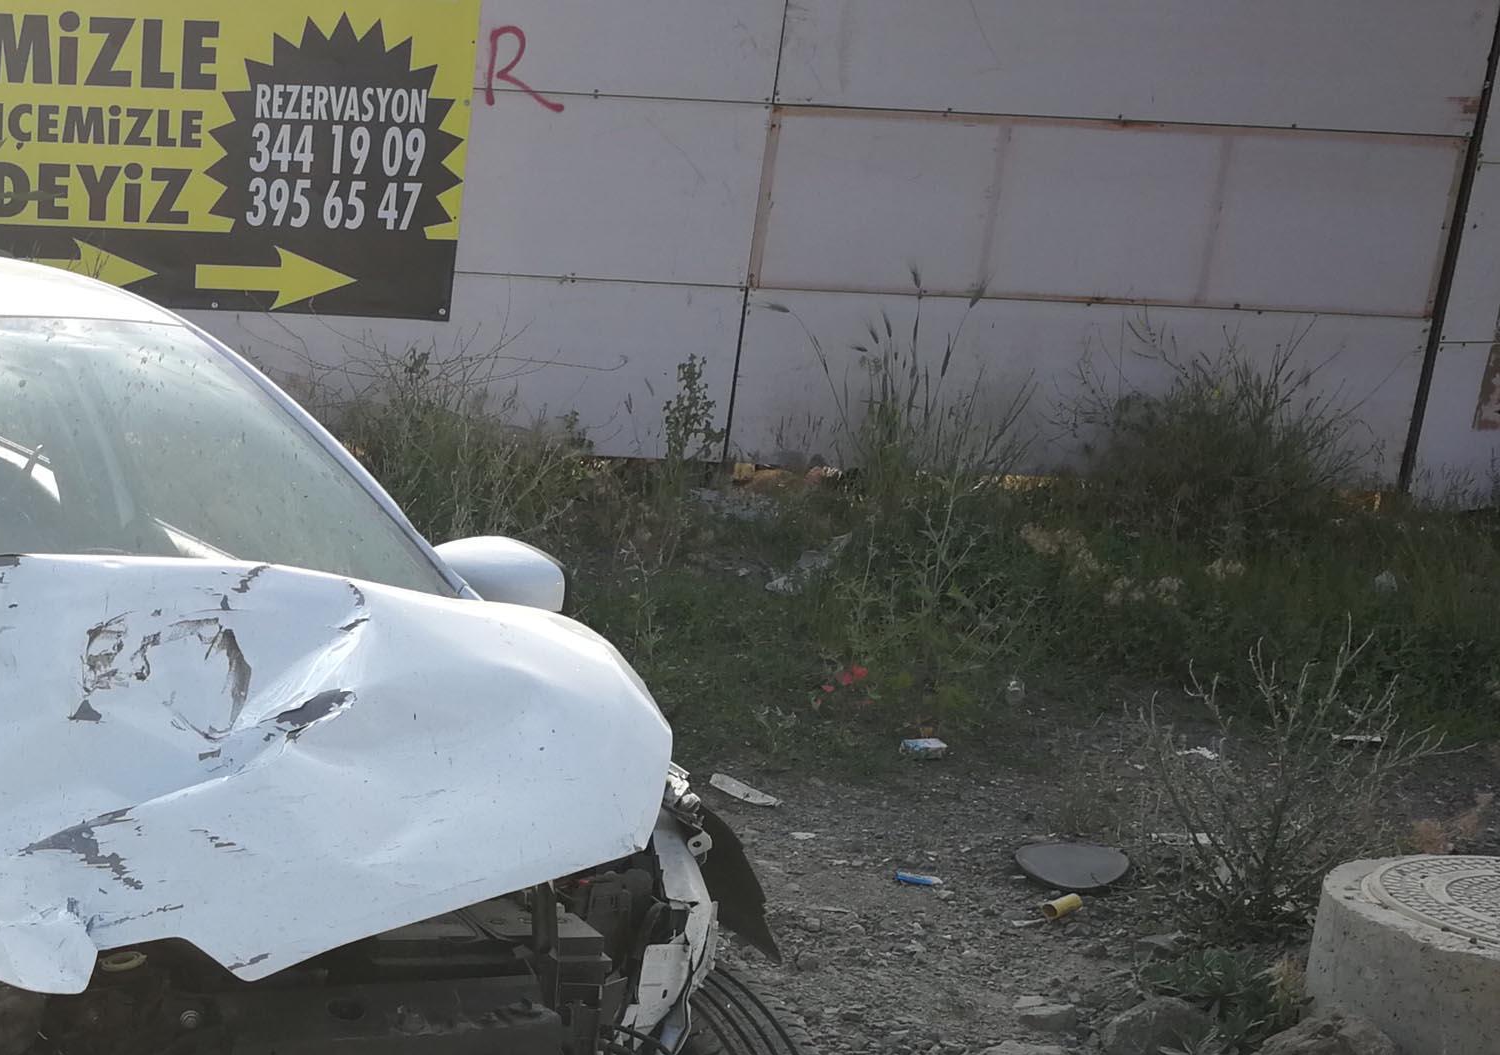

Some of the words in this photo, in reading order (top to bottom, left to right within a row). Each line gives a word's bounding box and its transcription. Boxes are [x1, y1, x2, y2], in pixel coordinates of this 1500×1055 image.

[255, 83, 427, 124] REZERVASYON
[249, 122, 314, 173] 344
[331, 125, 371, 175] 19
[382, 126, 426, 177] 09
[246, 177, 311, 228] 395
[323, 180, 366, 229] 65
[377, 182, 423, 231] 47
